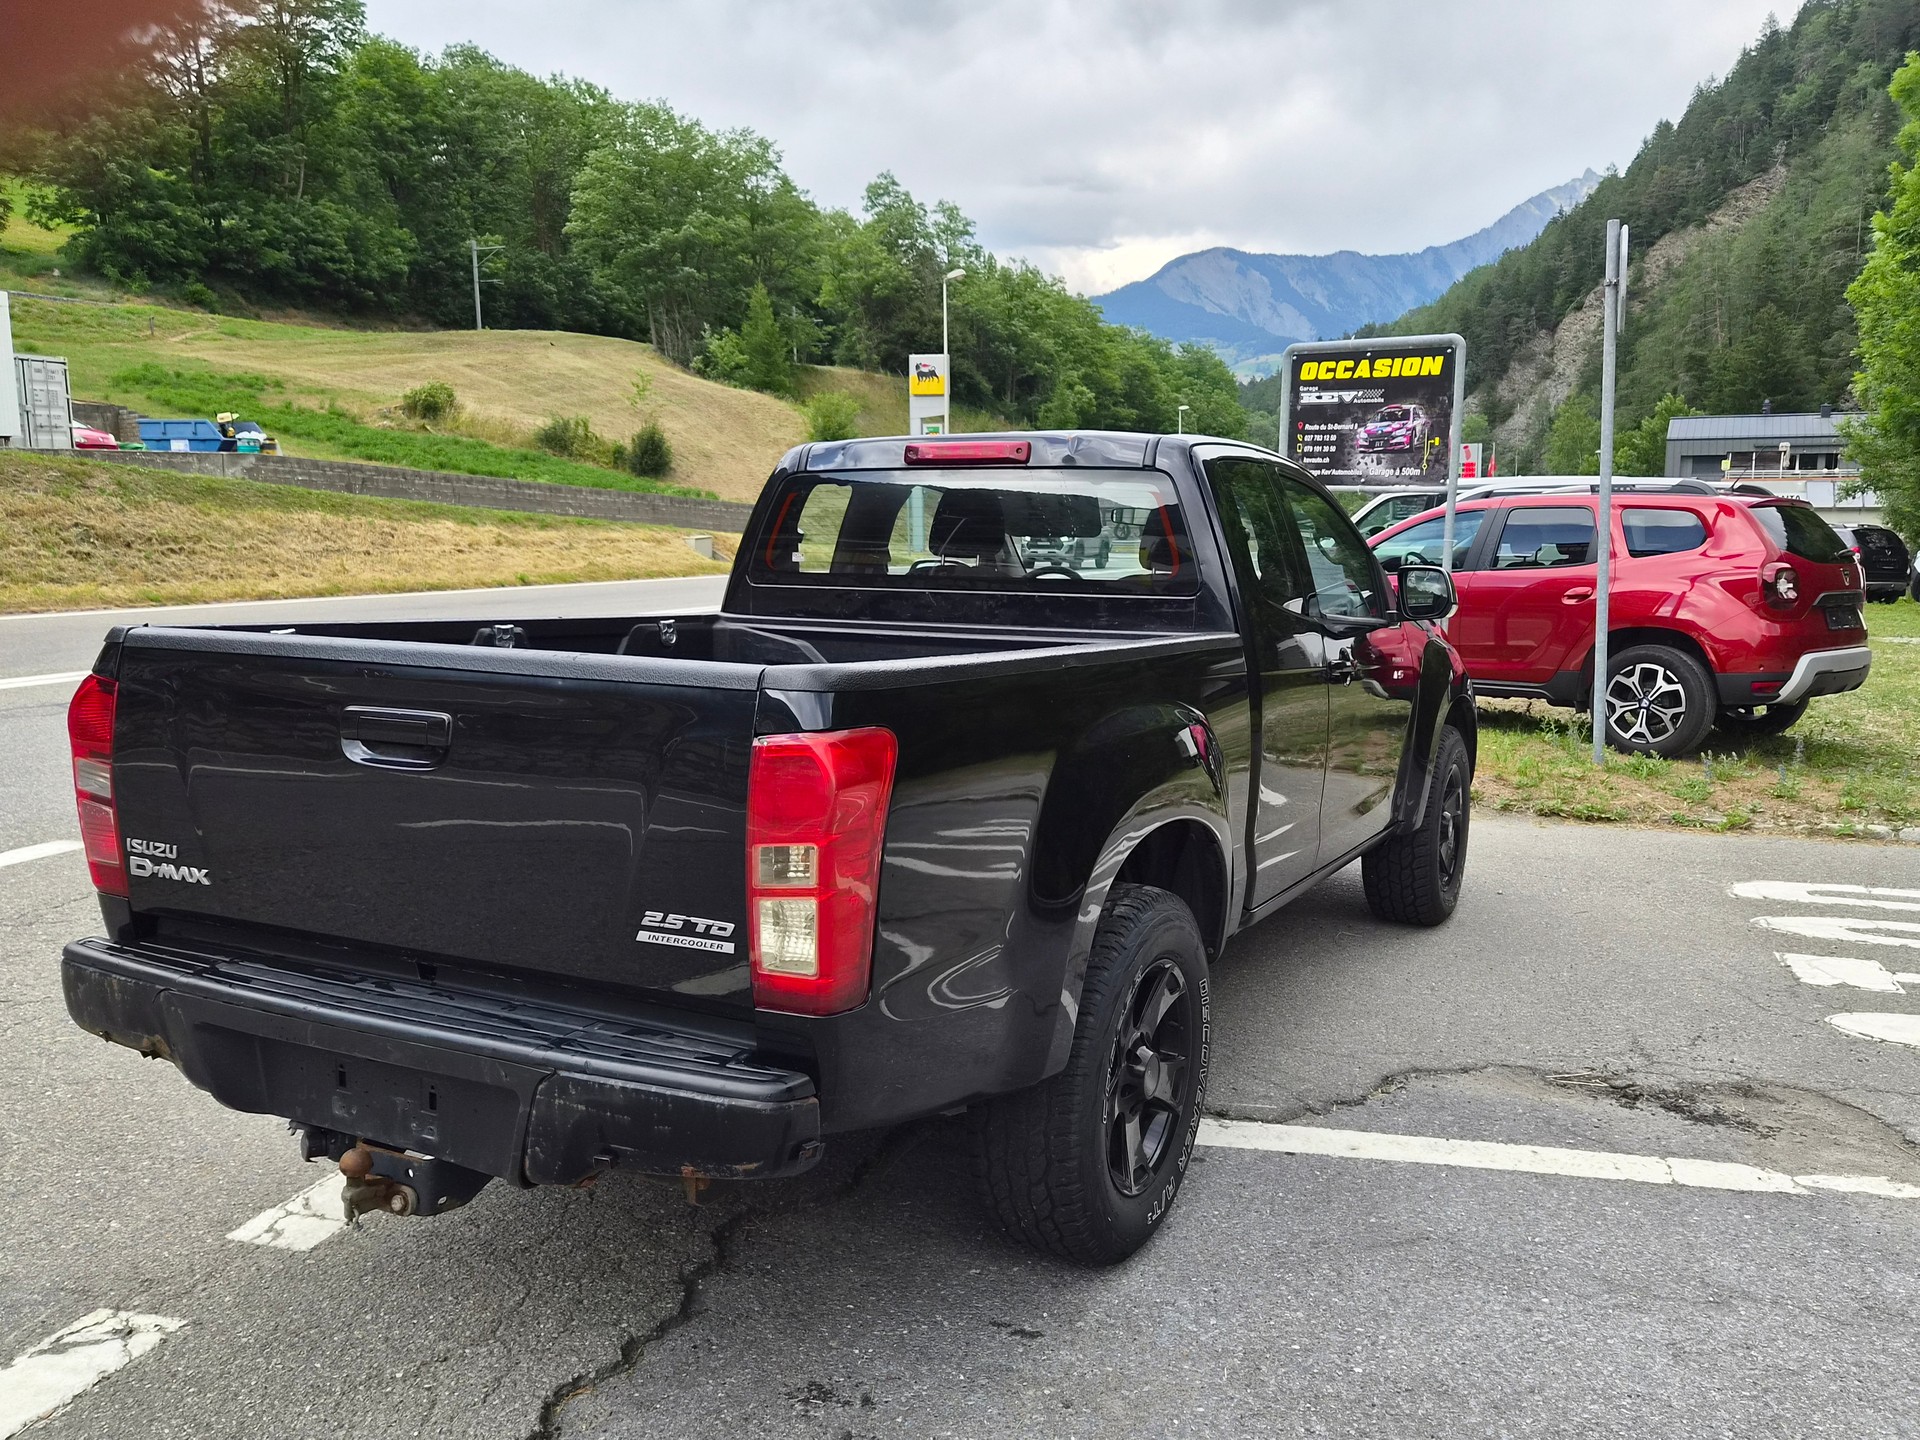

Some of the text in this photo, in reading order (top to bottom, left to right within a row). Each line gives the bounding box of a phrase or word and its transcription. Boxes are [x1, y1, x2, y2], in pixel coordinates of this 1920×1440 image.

[1300, 356, 1444, 381] OCCASION
[1304, 423, 1320, 431] Route
[1369, 467, 1393, 477] Garage
[1401, 467, 1421, 476] 500m
[126, 837, 177, 859] ISUZU
[129, 856, 211, 886] D-MAX
[647, 934, 724, 951] INTERCOOLER
